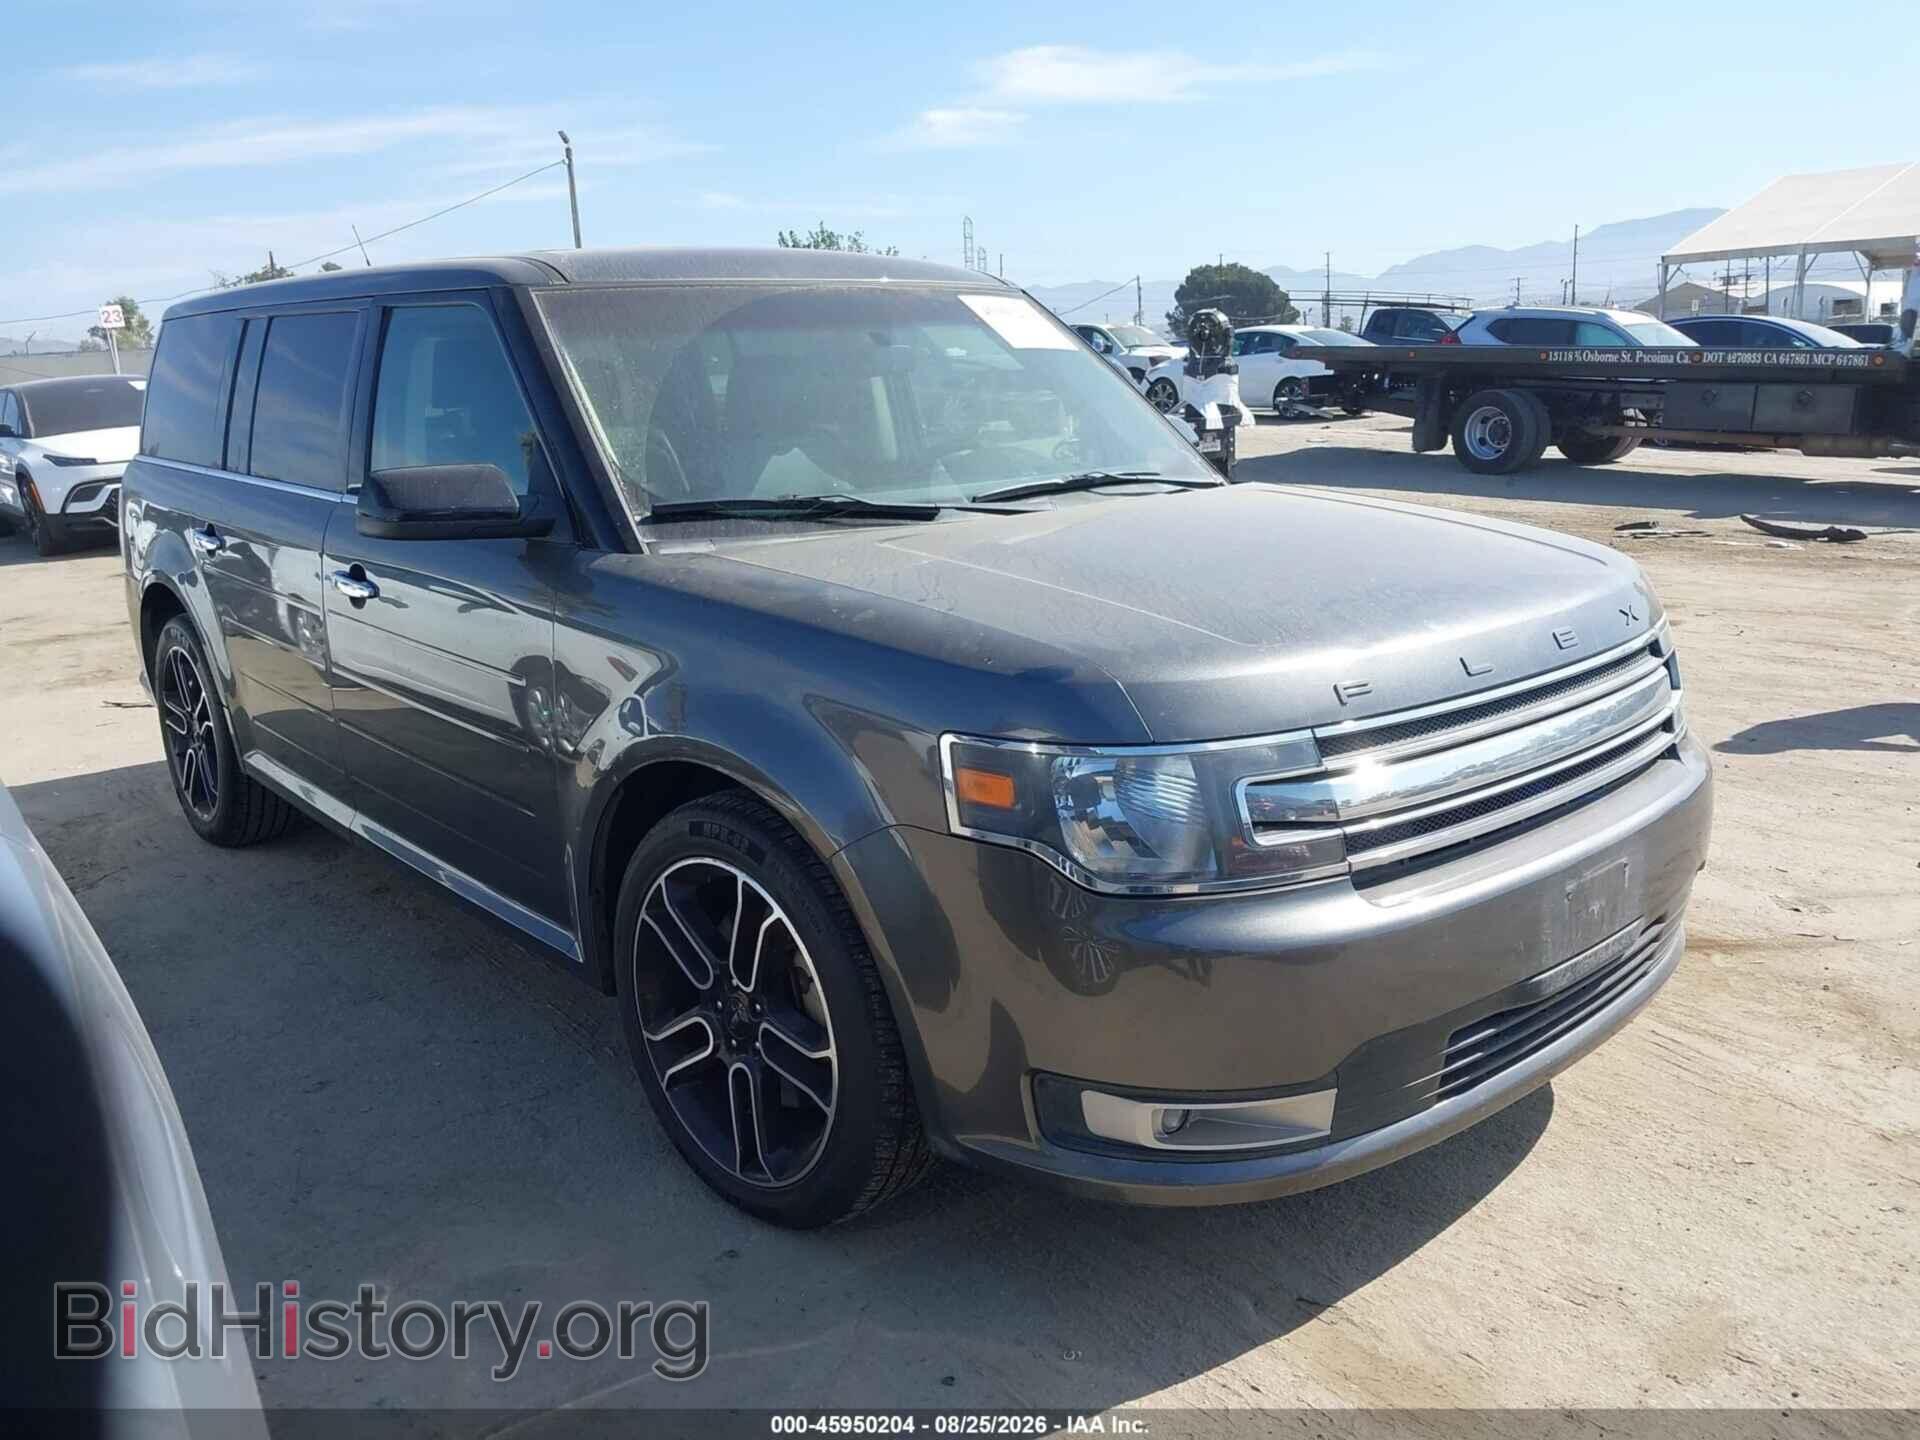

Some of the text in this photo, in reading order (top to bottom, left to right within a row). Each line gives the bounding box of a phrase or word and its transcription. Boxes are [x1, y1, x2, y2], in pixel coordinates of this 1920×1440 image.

[102, 311, 122, 323] 23
[1583, 350, 1620, 362] Osborne
[1620, 350, 1633, 363] St.
[1635, 350, 1674, 363] Pacoima
[1703, 351, 1724, 363] DOT
[1764, 352, 1777, 364] CA
[1812, 353, 1835, 366] MCP
[1331, 604, 1640, 706] FLEX
